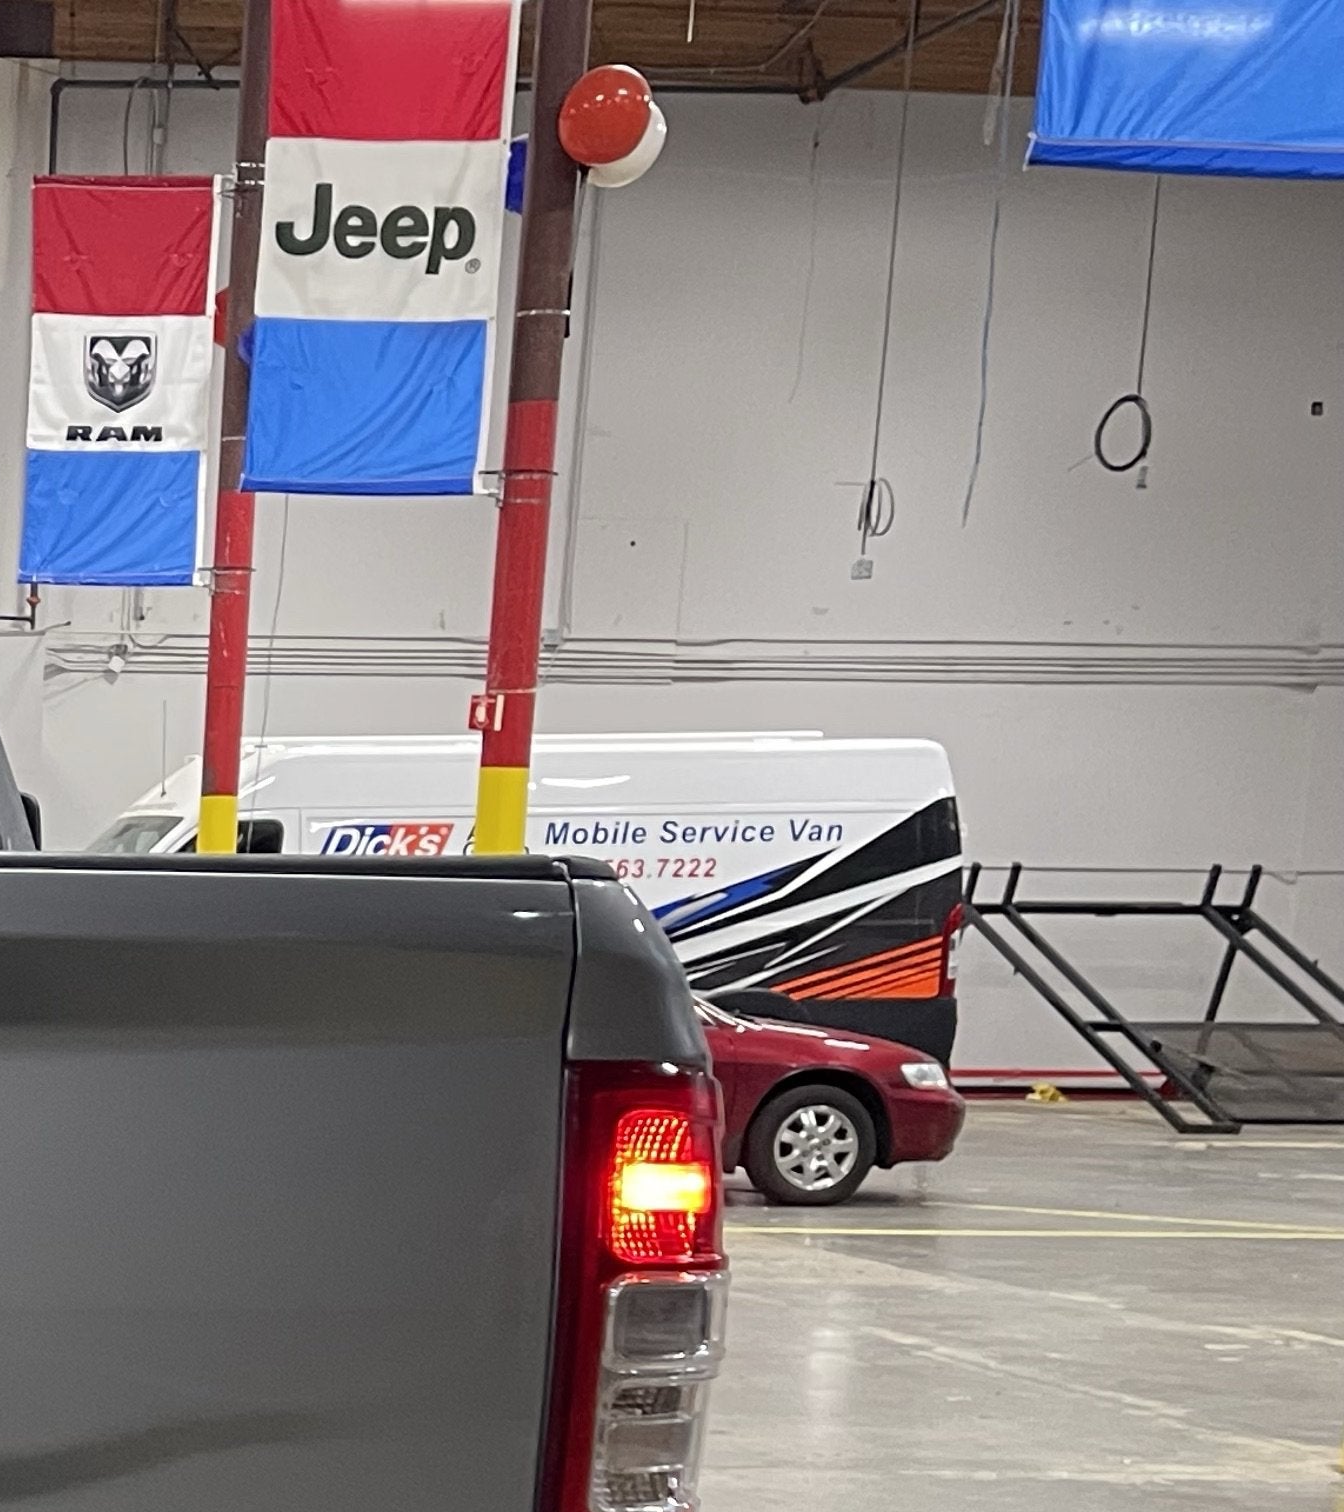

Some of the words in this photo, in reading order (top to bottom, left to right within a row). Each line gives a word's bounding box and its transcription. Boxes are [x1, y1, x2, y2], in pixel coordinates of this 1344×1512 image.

[275, 183, 476, 274] Jeep
[66, 425, 163, 442] RAM
[321, 824, 446, 856] Dick's
[545, 821, 647, 844] Mobile
[660, 820, 775, 843] Service
[789, 819, 843, 842] Van
[605, 858, 717, 878] 63.7222
